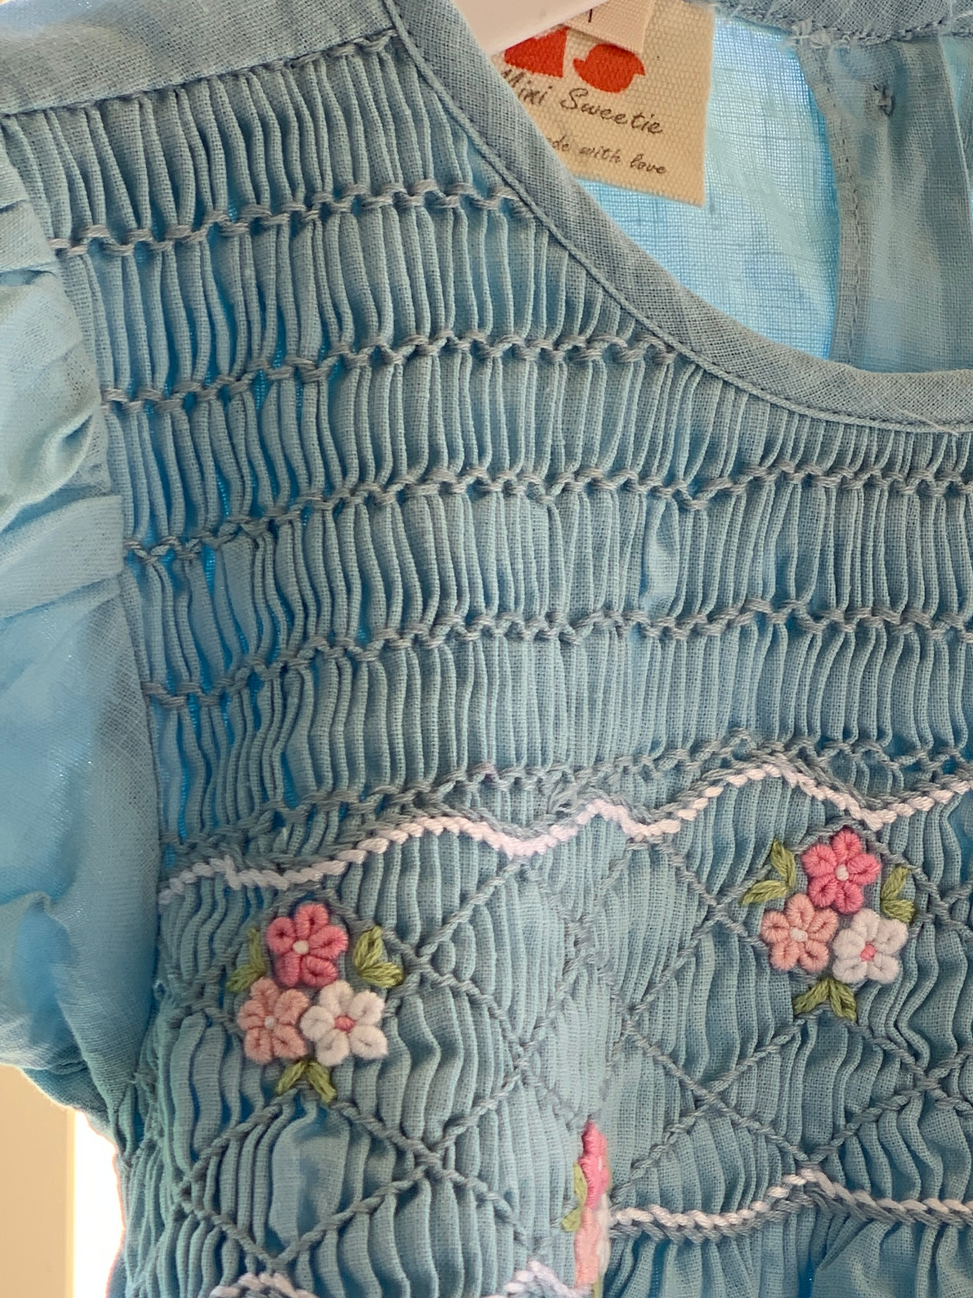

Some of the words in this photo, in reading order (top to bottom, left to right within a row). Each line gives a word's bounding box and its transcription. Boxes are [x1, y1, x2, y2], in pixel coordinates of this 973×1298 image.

[559, 87, 663, 134] Sweetie
[579, 146, 621, 163] with
[629, 153, 667, 174] love
